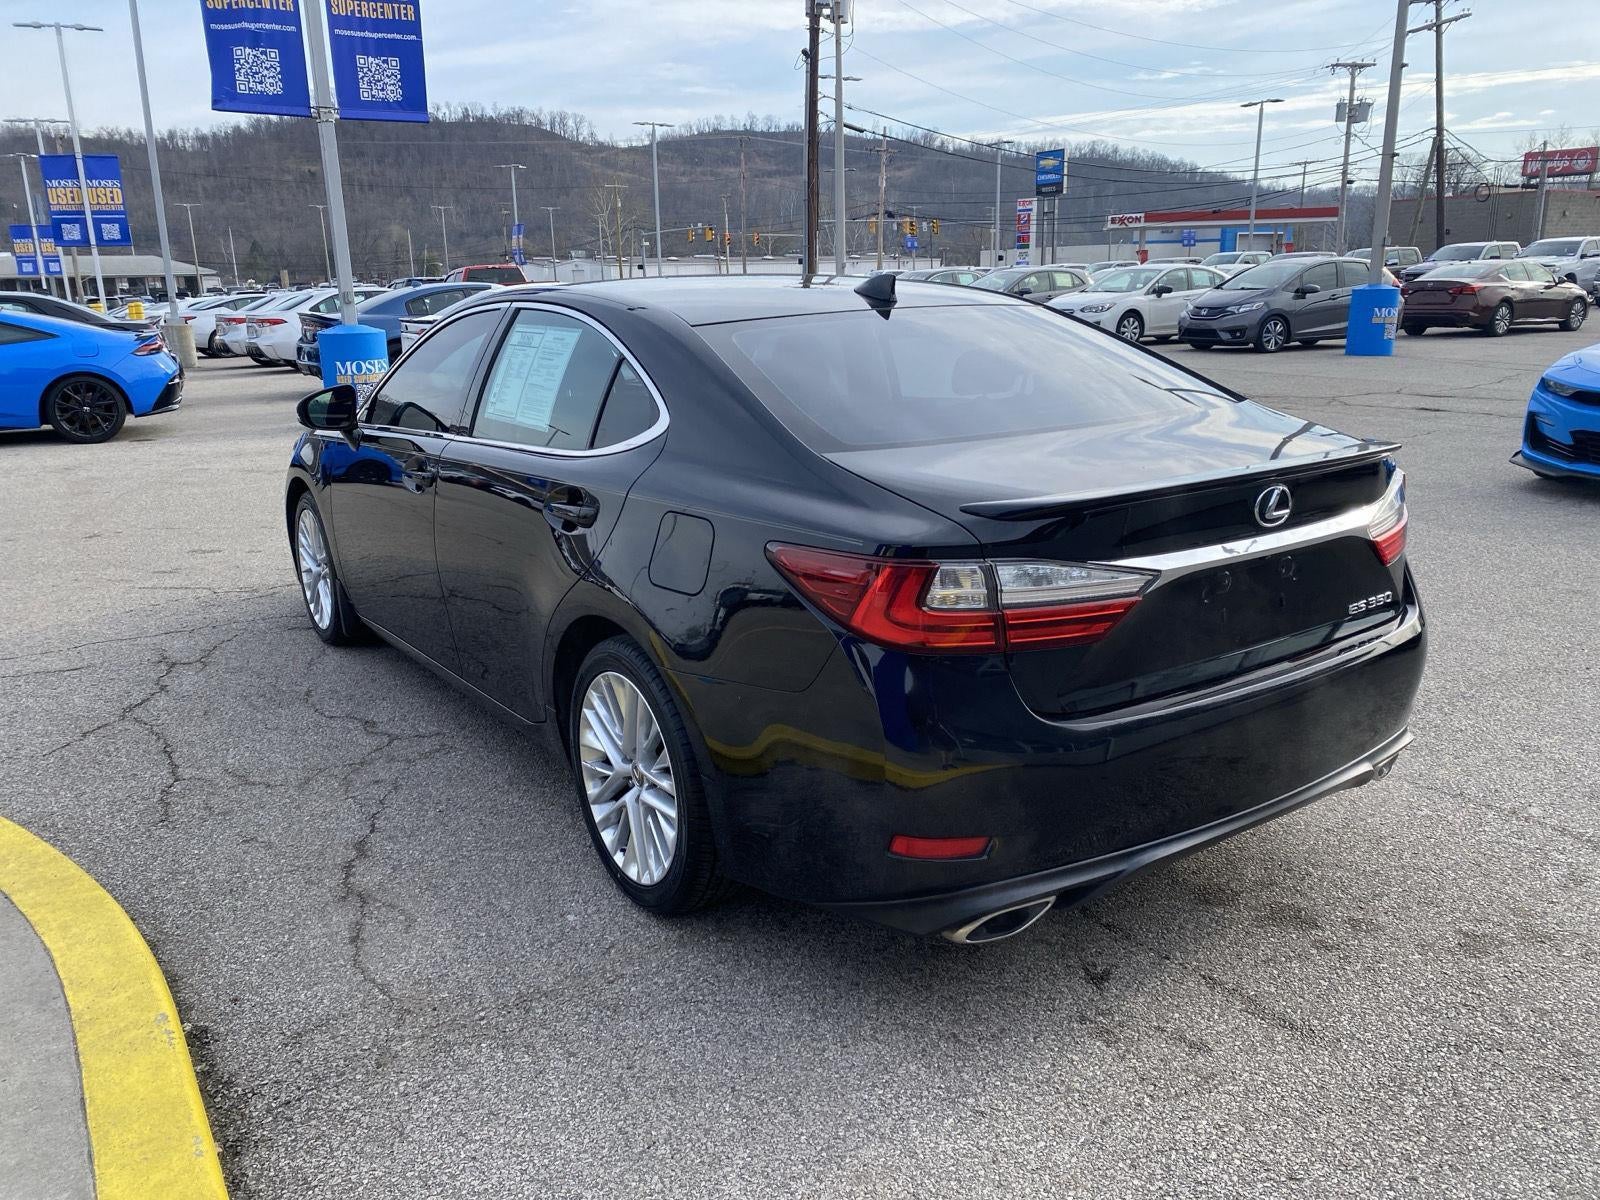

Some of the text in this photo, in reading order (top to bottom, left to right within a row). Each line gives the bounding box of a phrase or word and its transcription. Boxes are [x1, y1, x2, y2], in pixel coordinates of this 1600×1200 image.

[330, 0, 415, 21] SUPERCENTER
[210, 20, 297, 32] mosesusedsupercenter.com
[334, 28, 417, 41] mosesusedsupercenter.com
[46, 179, 80, 187] MOSES
[87, 179, 120, 187] MOSES
[47, 188, 83, 204] USED
[88, 188, 122, 204] USED
[1110, 215, 1142, 226] EXXON
[14, 243, 34, 253] USED
[41, 242, 57, 252] USE
[1373, 307, 1398, 318] MOS
[336, 359, 388, 375] MOSES
[1349, 591, 1393, 614] ES 350
